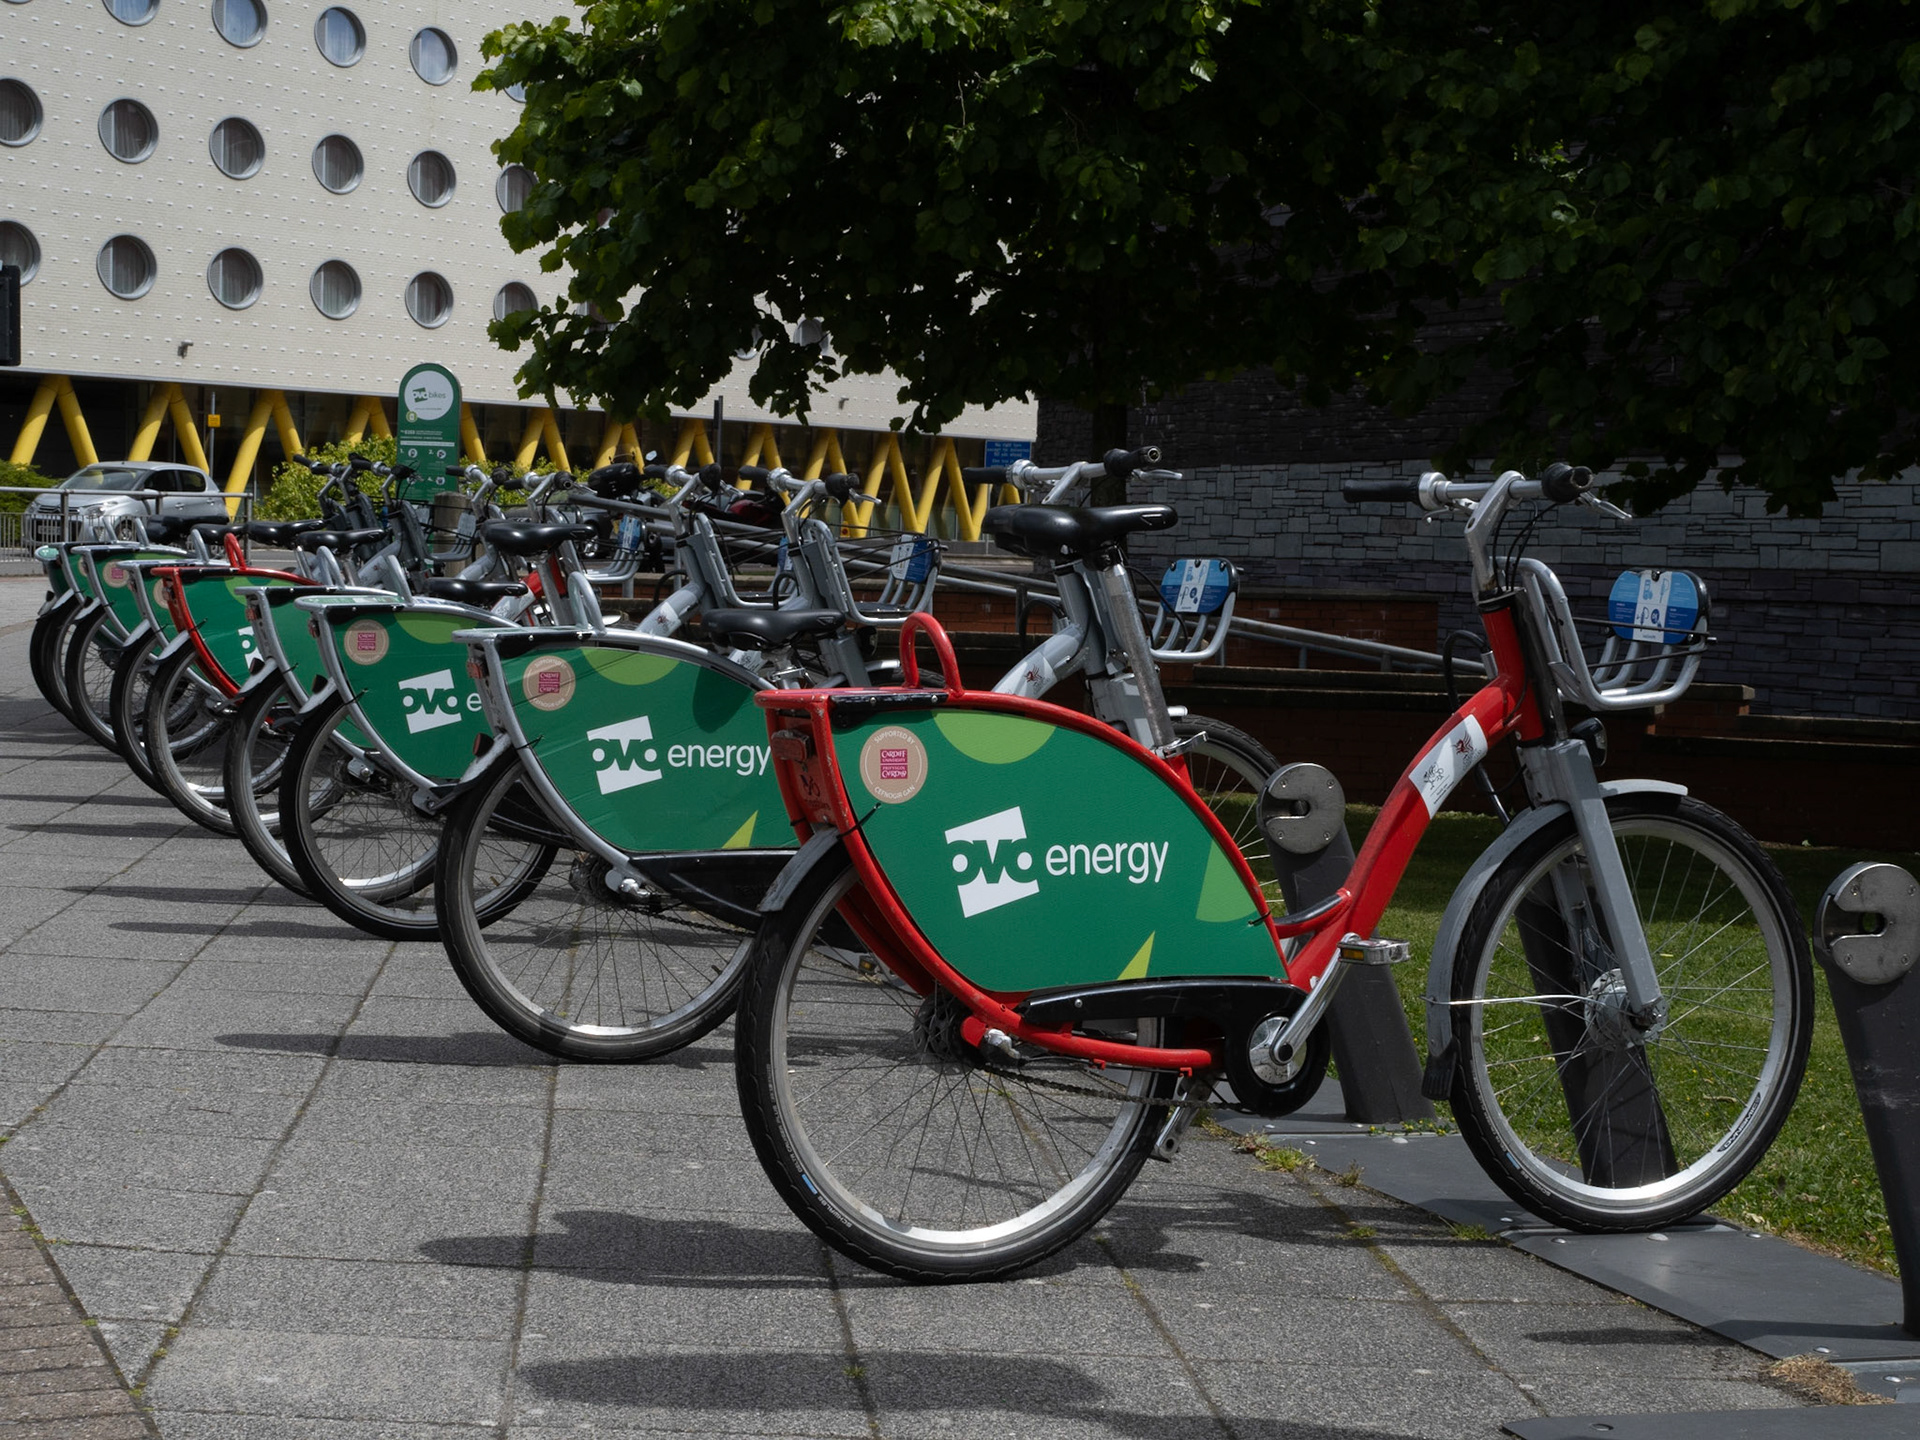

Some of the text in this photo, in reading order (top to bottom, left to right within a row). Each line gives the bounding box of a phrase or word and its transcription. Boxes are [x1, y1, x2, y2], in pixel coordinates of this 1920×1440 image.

[428, 391, 446, 399] bikes
[874, 730, 916, 745] SUPPORTED BY
[667, 744, 771, 777] energy
[881, 750, 907, 758] CARDIFF
[902, 786, 916, 797] GAN
[1045, 841, 1169, 885] energy
[817, 1195, 853, 1228] SCHWALBE
